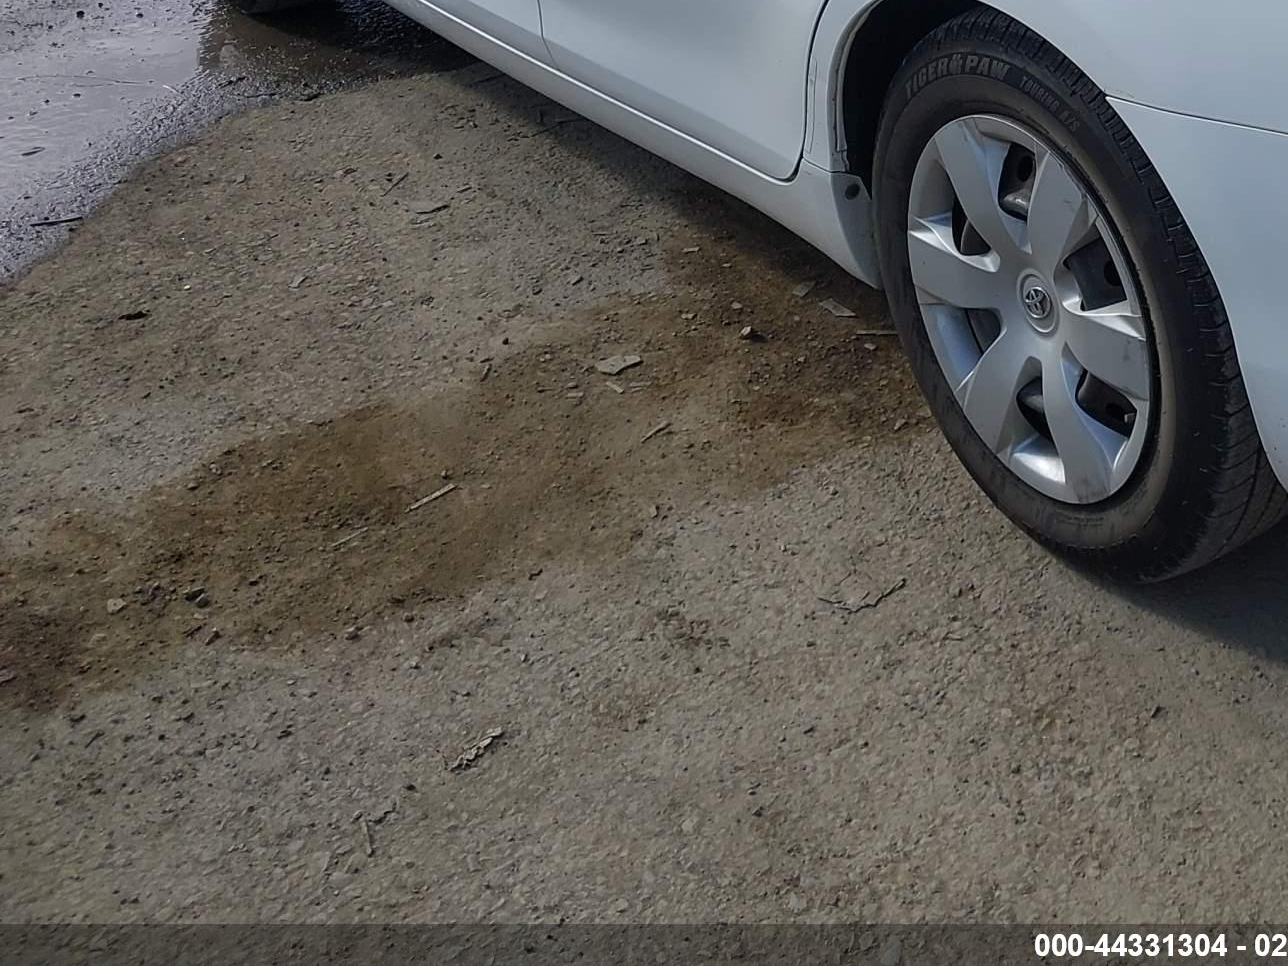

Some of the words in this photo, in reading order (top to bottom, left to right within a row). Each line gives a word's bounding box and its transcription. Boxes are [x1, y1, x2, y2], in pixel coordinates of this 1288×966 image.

[904, 57, 950, 99] TIGER
[964, 54, 1011, 81] PAW
[1018, 75, 1061, 113] TOURING
